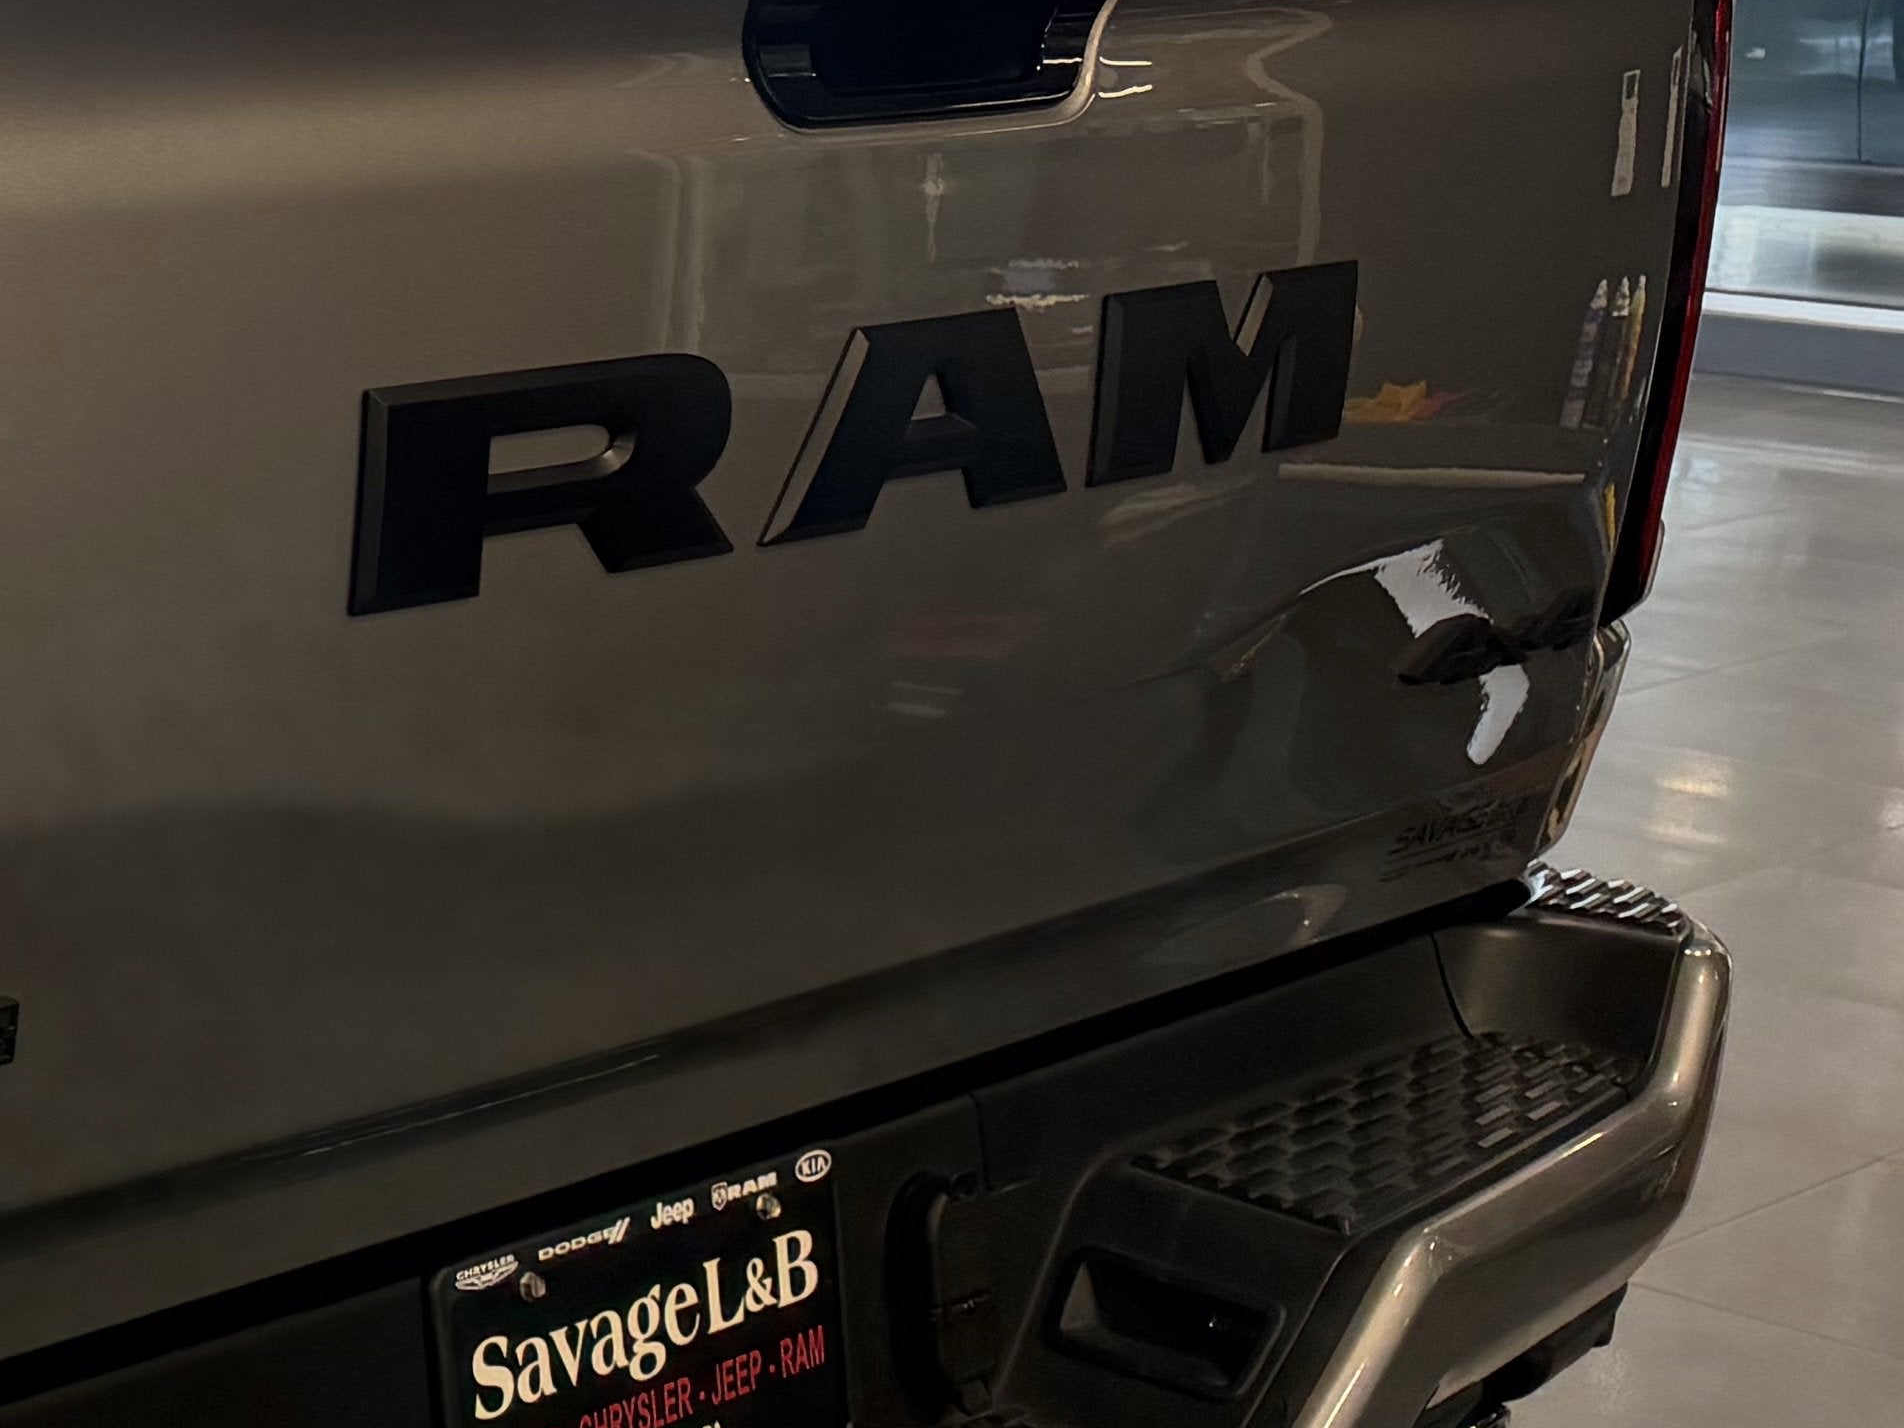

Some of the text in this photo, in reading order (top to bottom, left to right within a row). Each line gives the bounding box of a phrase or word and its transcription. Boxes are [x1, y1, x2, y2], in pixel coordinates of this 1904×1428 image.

[348, 259, 1359, 617] RAM
[455, 1253, 515, 1281] CHRYSLER
[650, 1197, 695, 1230] Jeep
[726, 1171, 778, 1202] RAM
[711, 1349, 762, 1405] JEEP
[780, 1325, 825, 1378] RAM
